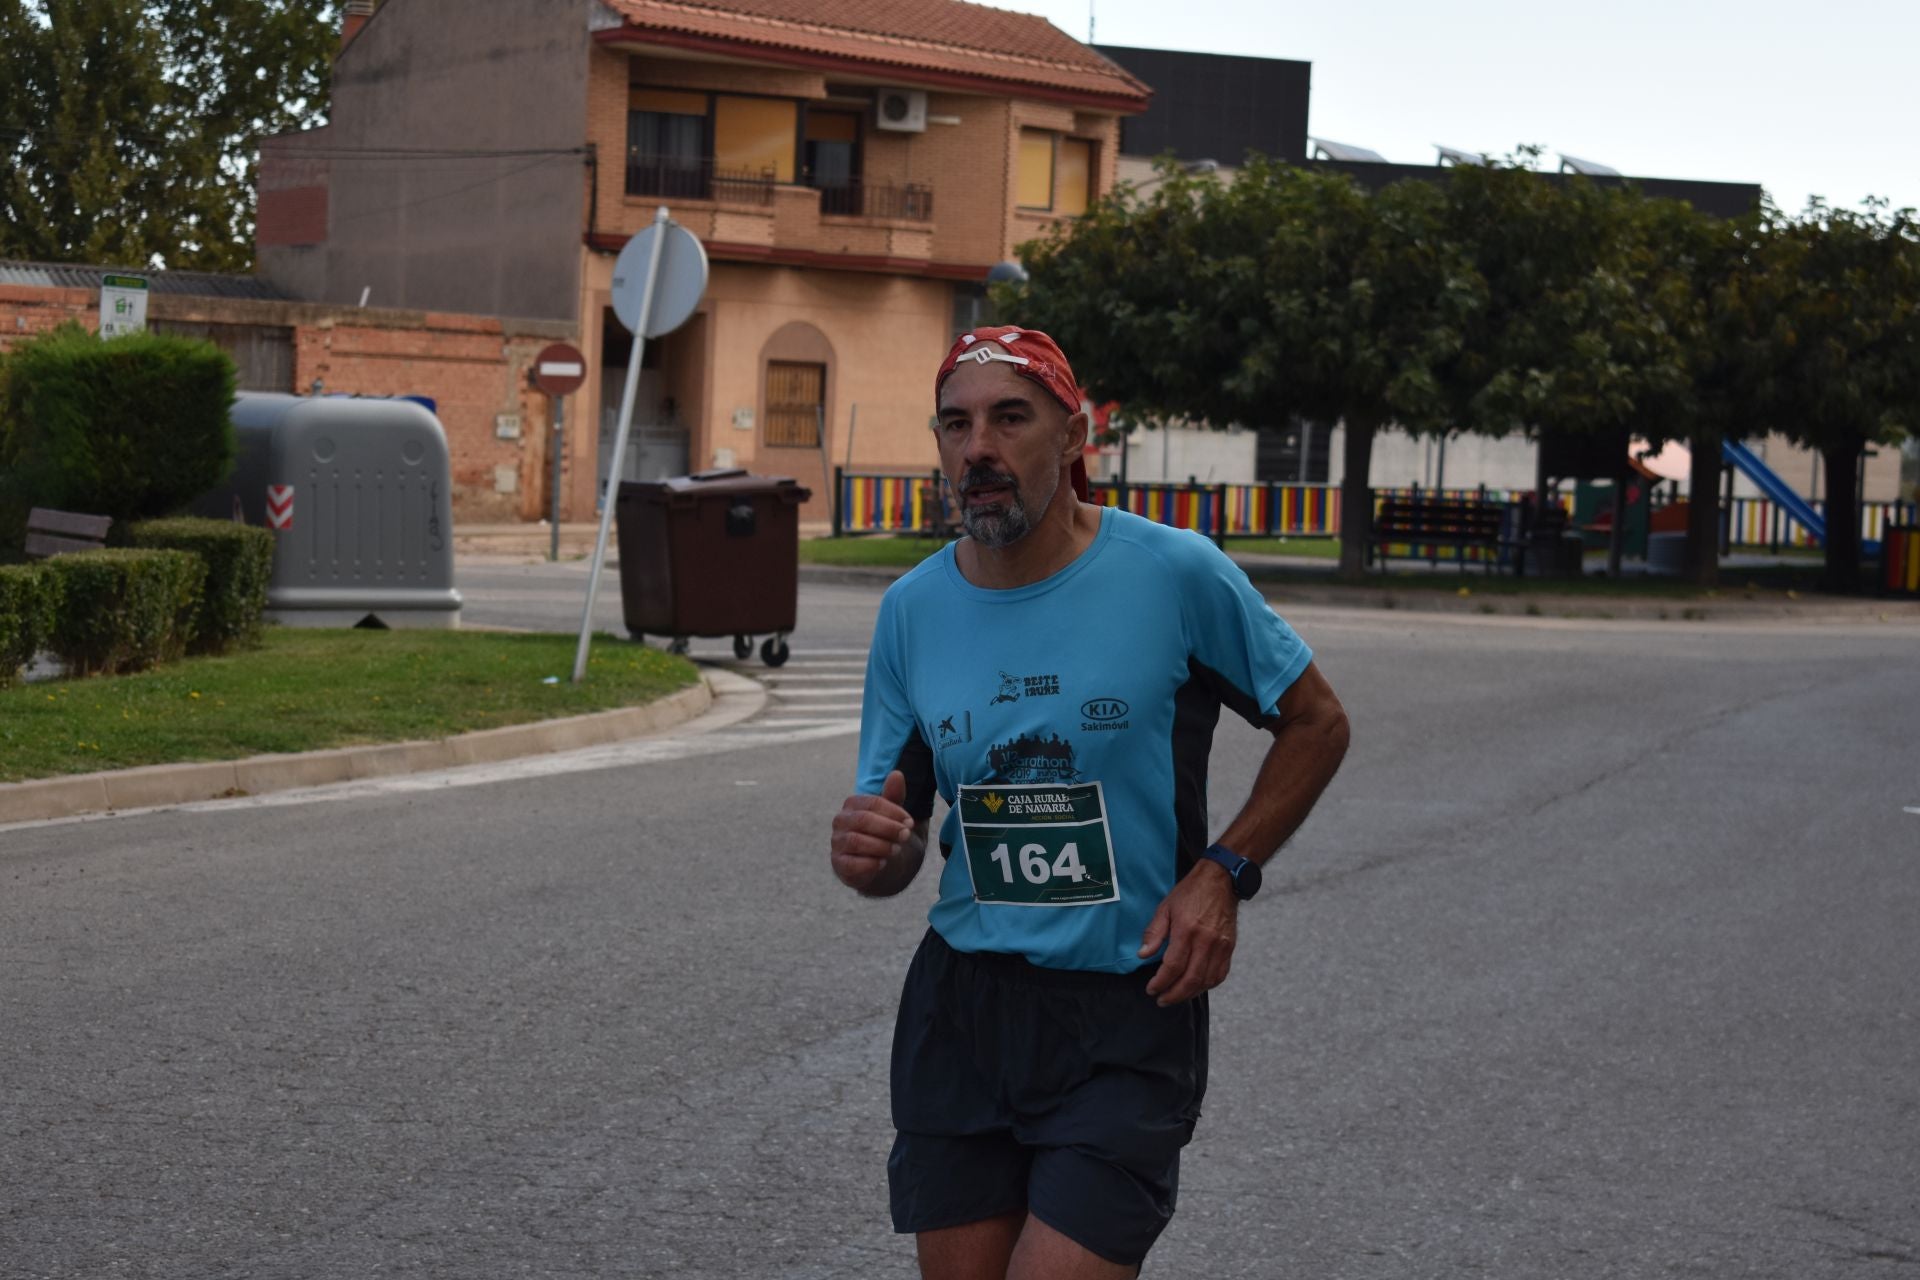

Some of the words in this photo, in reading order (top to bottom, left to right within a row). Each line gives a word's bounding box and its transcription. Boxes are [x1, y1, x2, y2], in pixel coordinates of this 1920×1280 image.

[1023, 674, 1059, 686] BESTE
[1089, 702, 1122, 716] KIA
[1081, 720, 1129, 731] Sakimóvil
[1009, 768, 1031, 779] 2019
[1007, 794, 1032, 804] CAJA
[1034, 793, 1070, 804] RURAL
[1009, 804, 1023, 814] DE
[1025, 803, 1075, 814] NAVARRA
[990, 842, 1087, 885] 164
